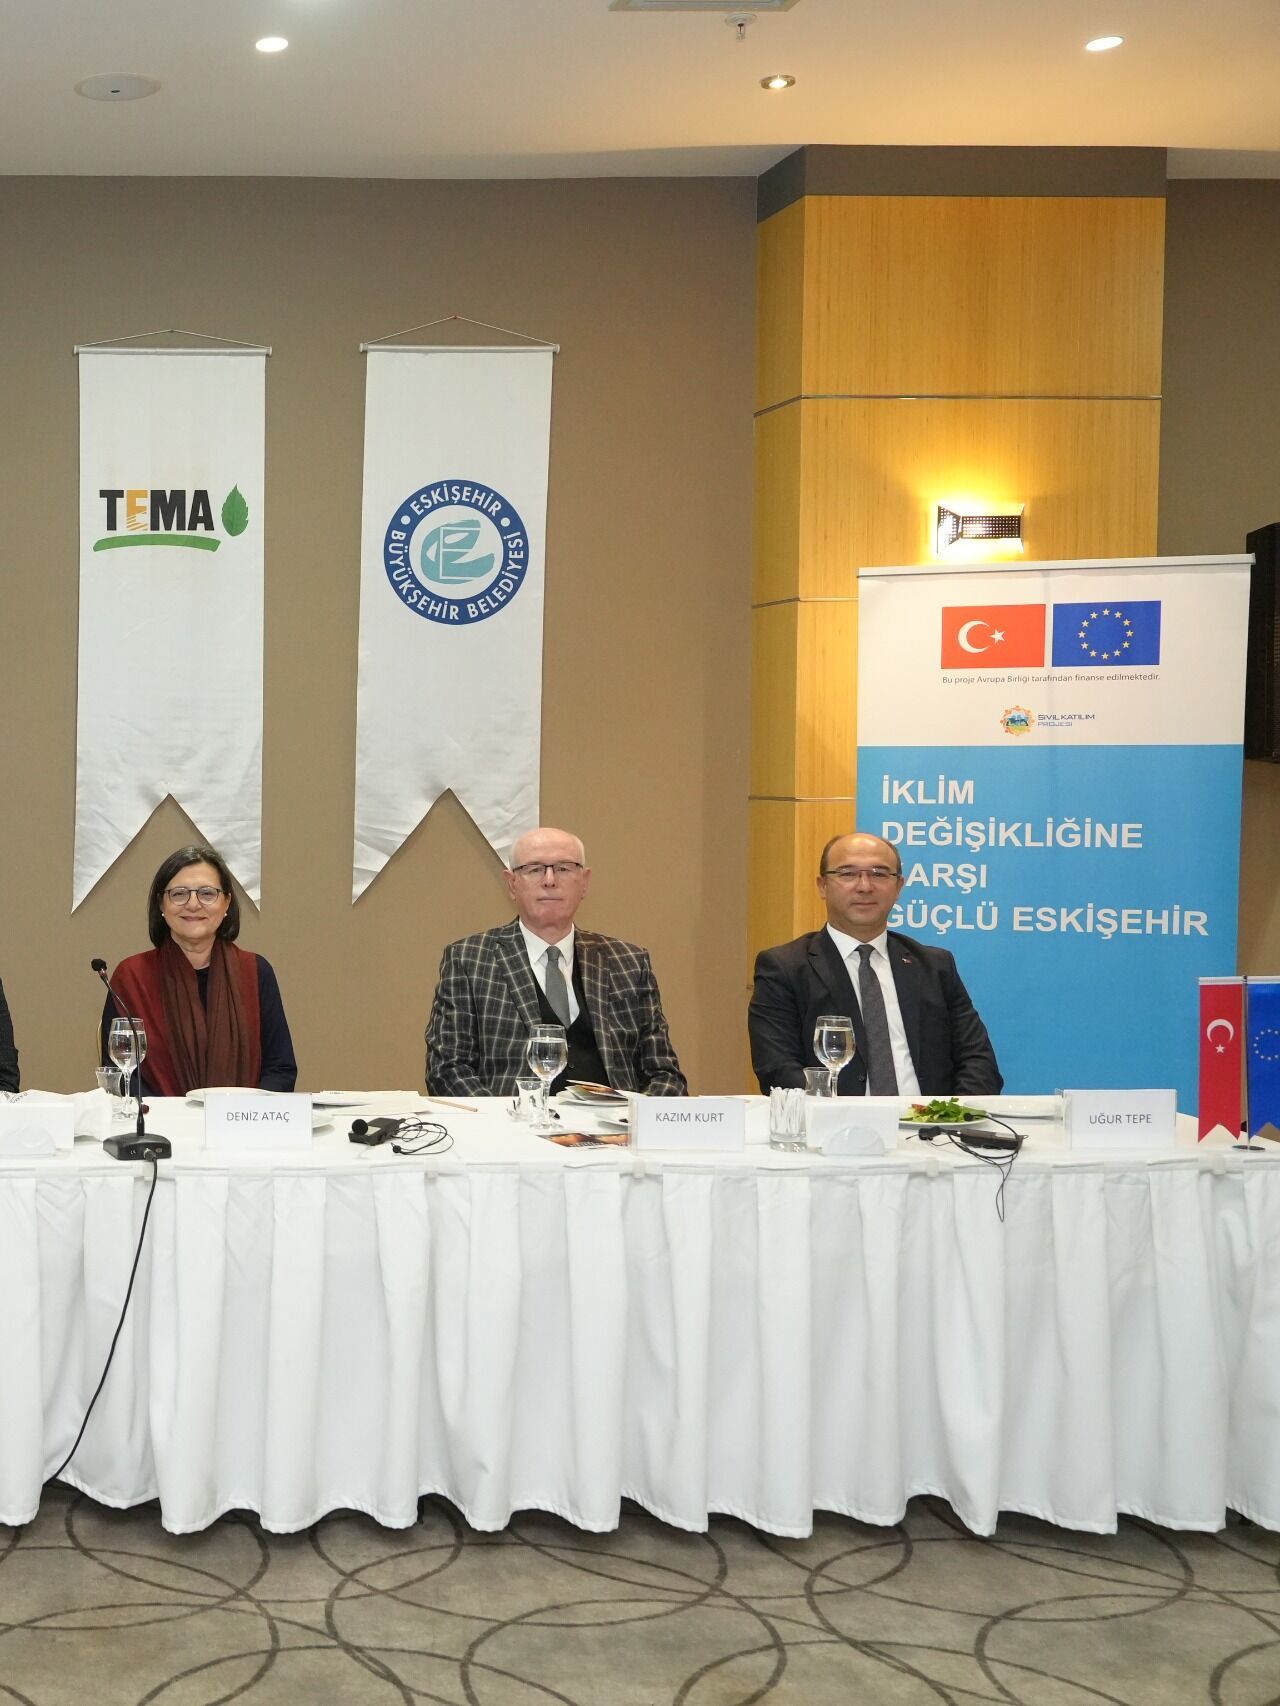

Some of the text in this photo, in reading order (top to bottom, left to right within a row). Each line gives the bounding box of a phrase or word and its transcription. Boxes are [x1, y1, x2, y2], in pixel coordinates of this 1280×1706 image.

[99, 489, 215, 531] TEMA
[409, 483, 502, 517] ESKİŞEHİR
[388, 529, 524, 621] BÜYÜKŞEHİR BELEDİYESİ
[942, 676, 953, 684] Bu
[954, 676, 975, 685] proje
[976, 675, 1005, 685] Avrupa
[1075, 673, 1105, 682] finanse
[882, 774, 975, 805] İKLİM
[881, 816, 1143, 853] DEĞİŞİKLİĞİNE
[901, 862, 987, 894] ARŞI
[1012, 903, 1209, 940] ESKİŞEHİR
[226, 1109, 290, 1123] DENİZ ATAÇ
[655, 1112, 725, 1123] KAZIM KURT
[1089, 1112, 1153, 1124] UĞUR TEPE
